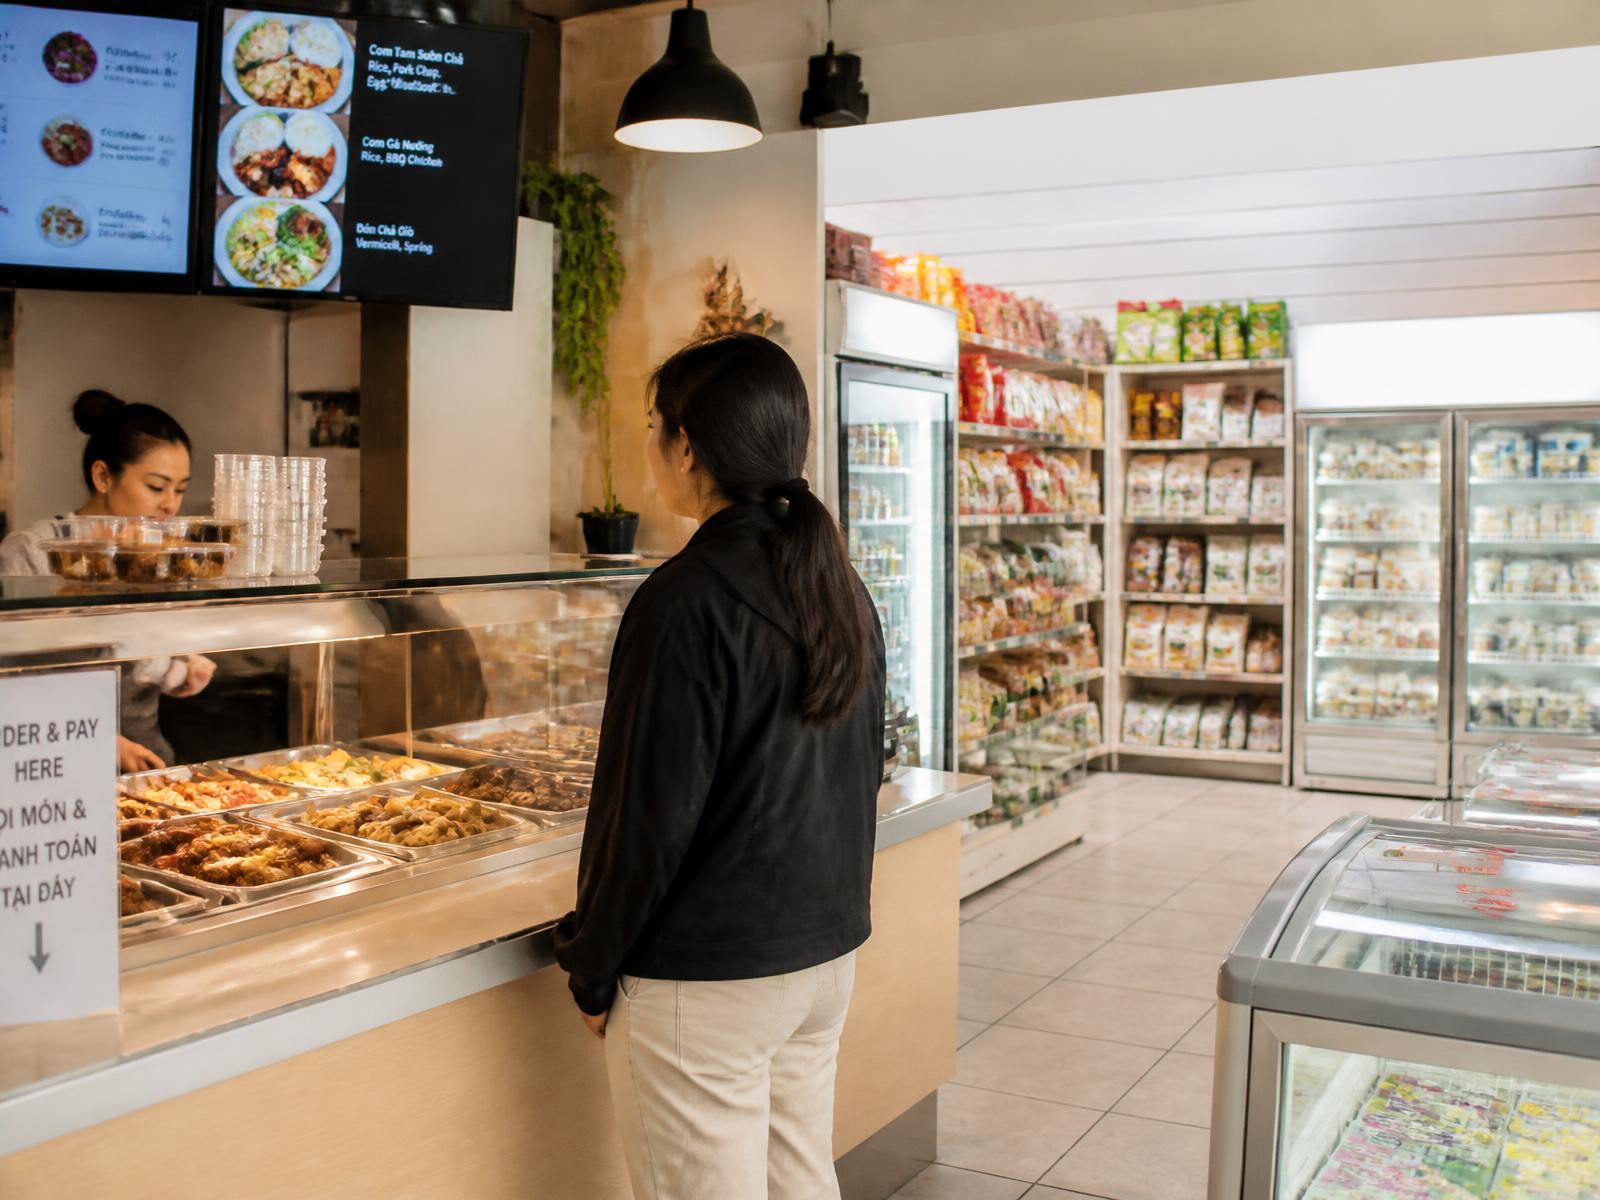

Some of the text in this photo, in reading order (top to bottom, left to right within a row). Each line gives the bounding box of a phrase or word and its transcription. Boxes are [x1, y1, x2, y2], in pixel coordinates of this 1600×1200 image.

[0, 718, 99, 747] DER & PAY
[15, 757, 64, 783] HERE
[21, 798, 67, 827] MÓN
[73, 799, 87, 819] &
[44, 833, 96, 863] TOÁN
